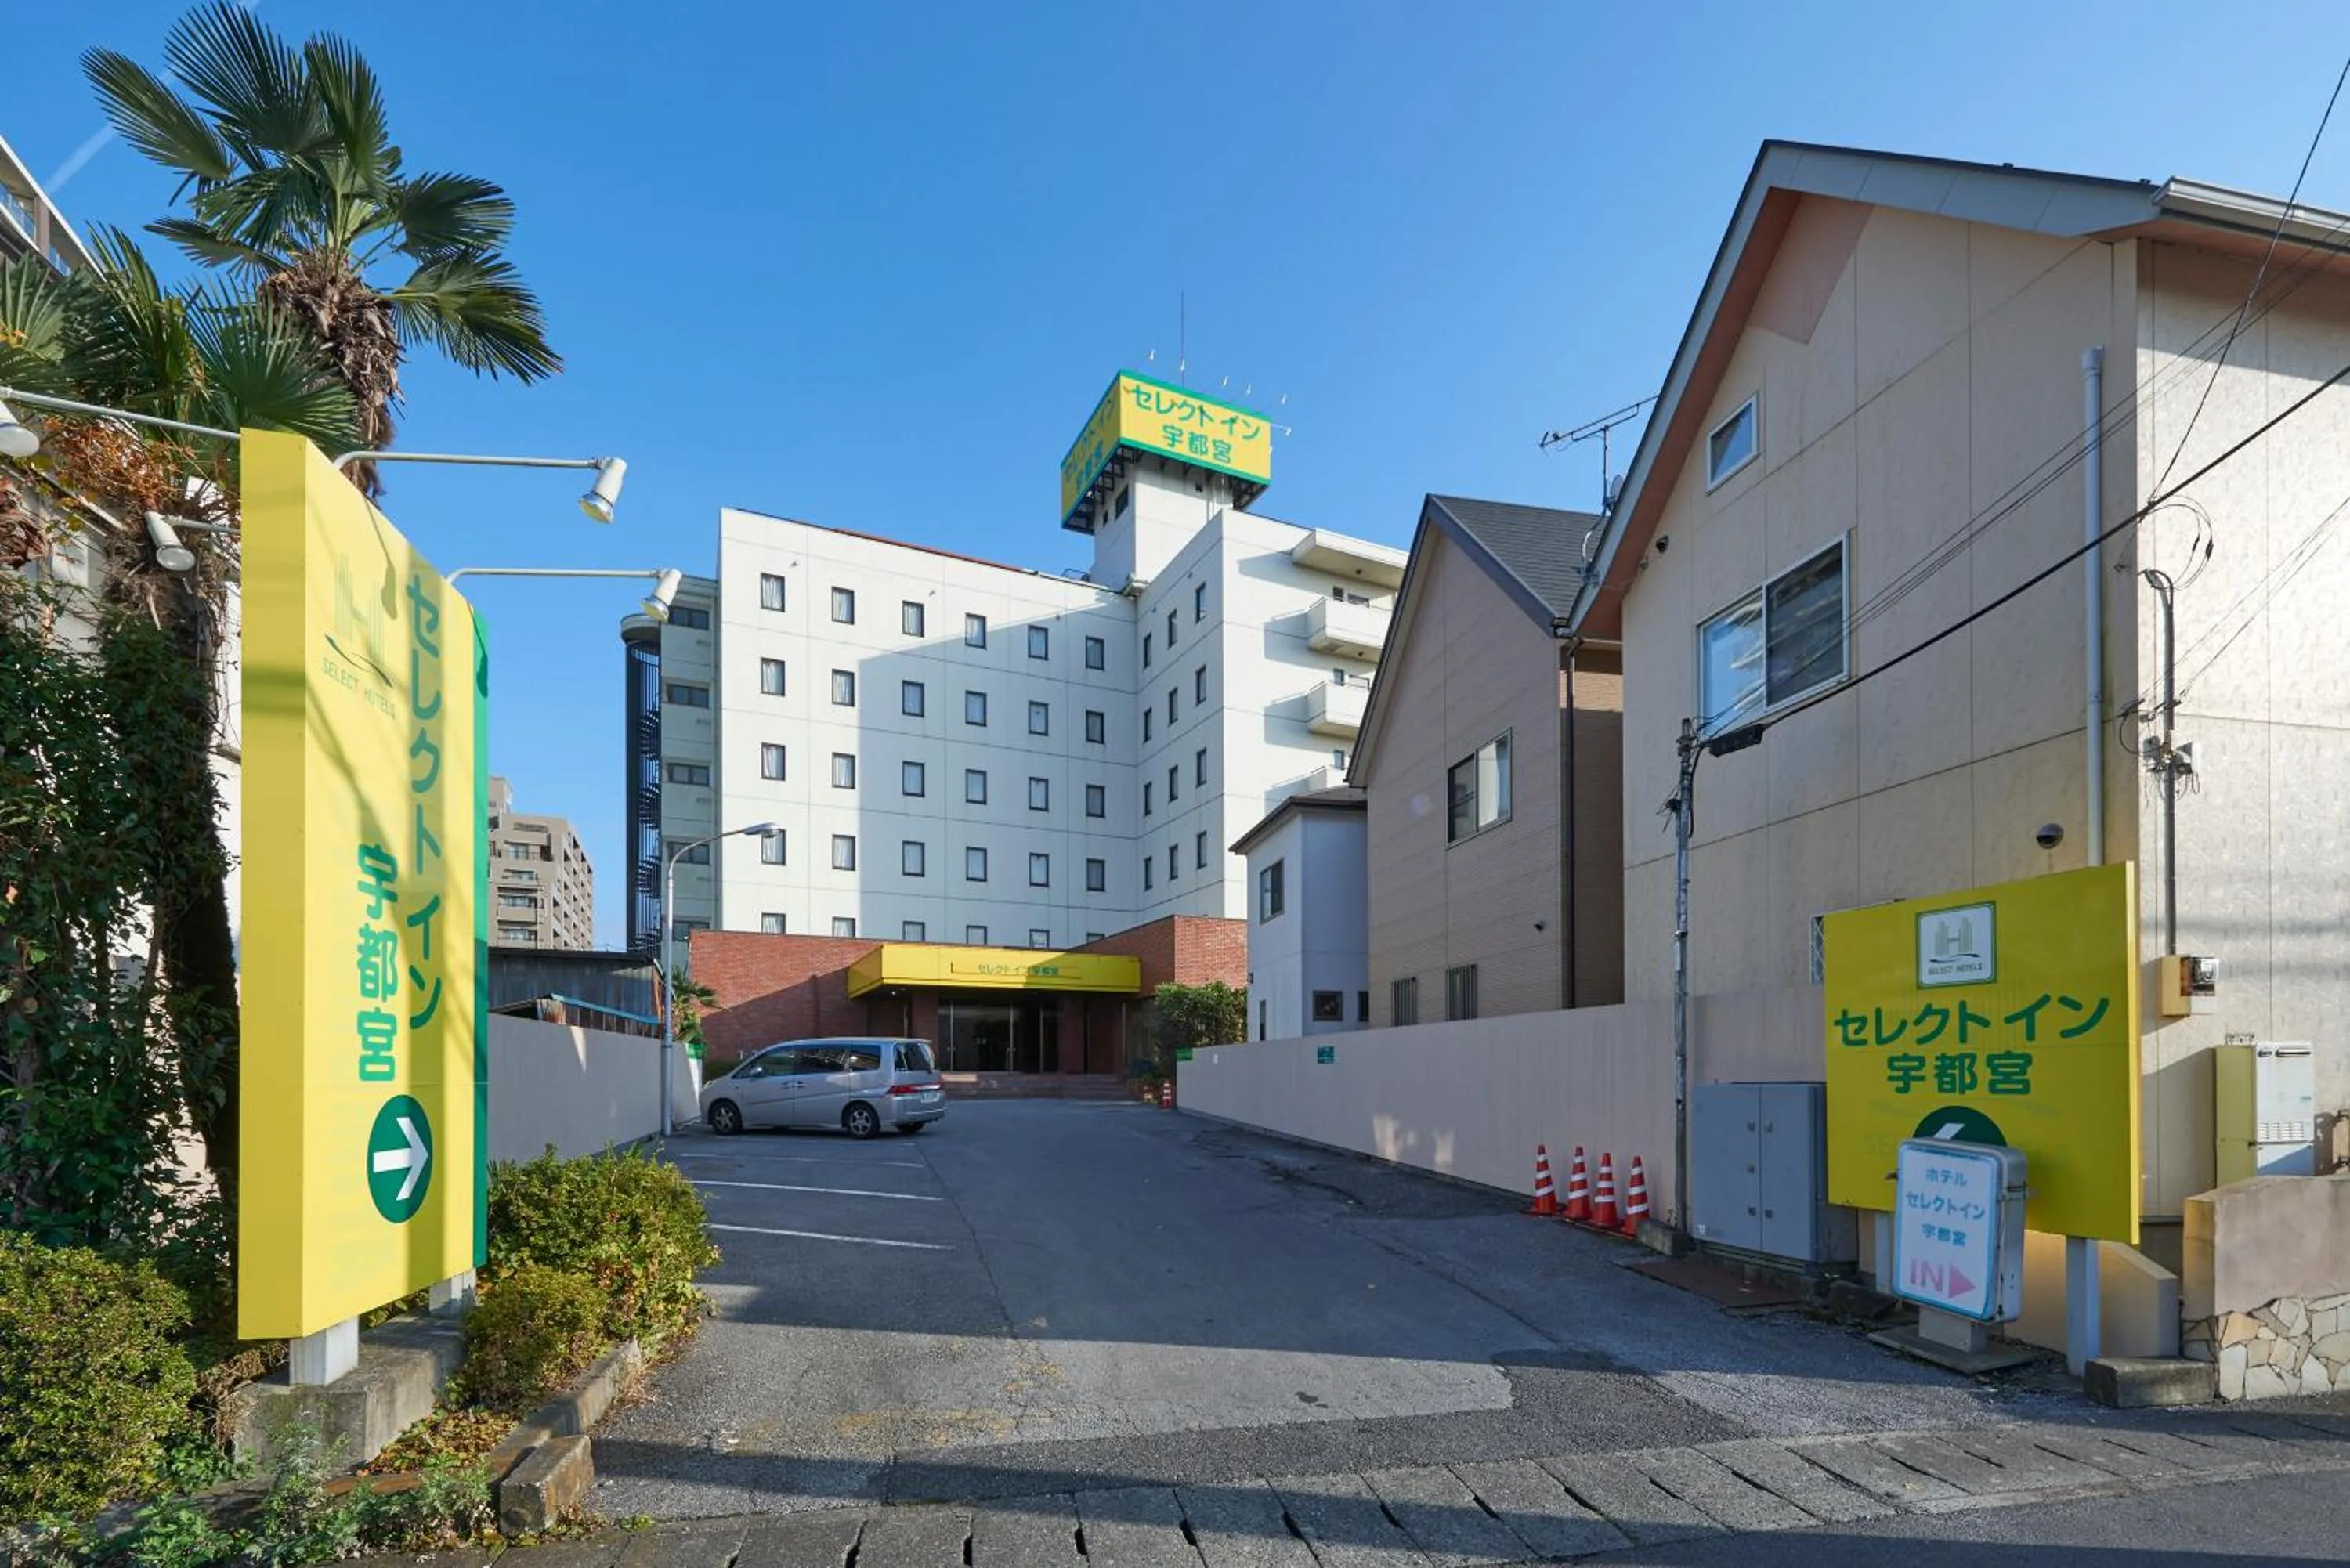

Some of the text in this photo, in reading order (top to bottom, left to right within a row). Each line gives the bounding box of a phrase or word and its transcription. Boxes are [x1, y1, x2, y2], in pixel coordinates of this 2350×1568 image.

[1122, 386, 1261, 439] セレクトイン
[1162, 424, 1232, 464] 宇都宮
[322, 656, 358, 693] SELECT
[405, 574, 442, 1028] セレクトイン
[356, 844, 398, 1082] 宇都宮
[1834, 994, 2110, 1047] セレクトイン
[1887, 1051, 2033, 1095] 宇都宮
[1925, 1167, 1968, 1187] ホテル
[1906, 1190, 1986, 1220] セレクトイン
[1922, 1224, 1967, 1247] 宇都宮
[1910, 1259, 1944, 1292] IN
